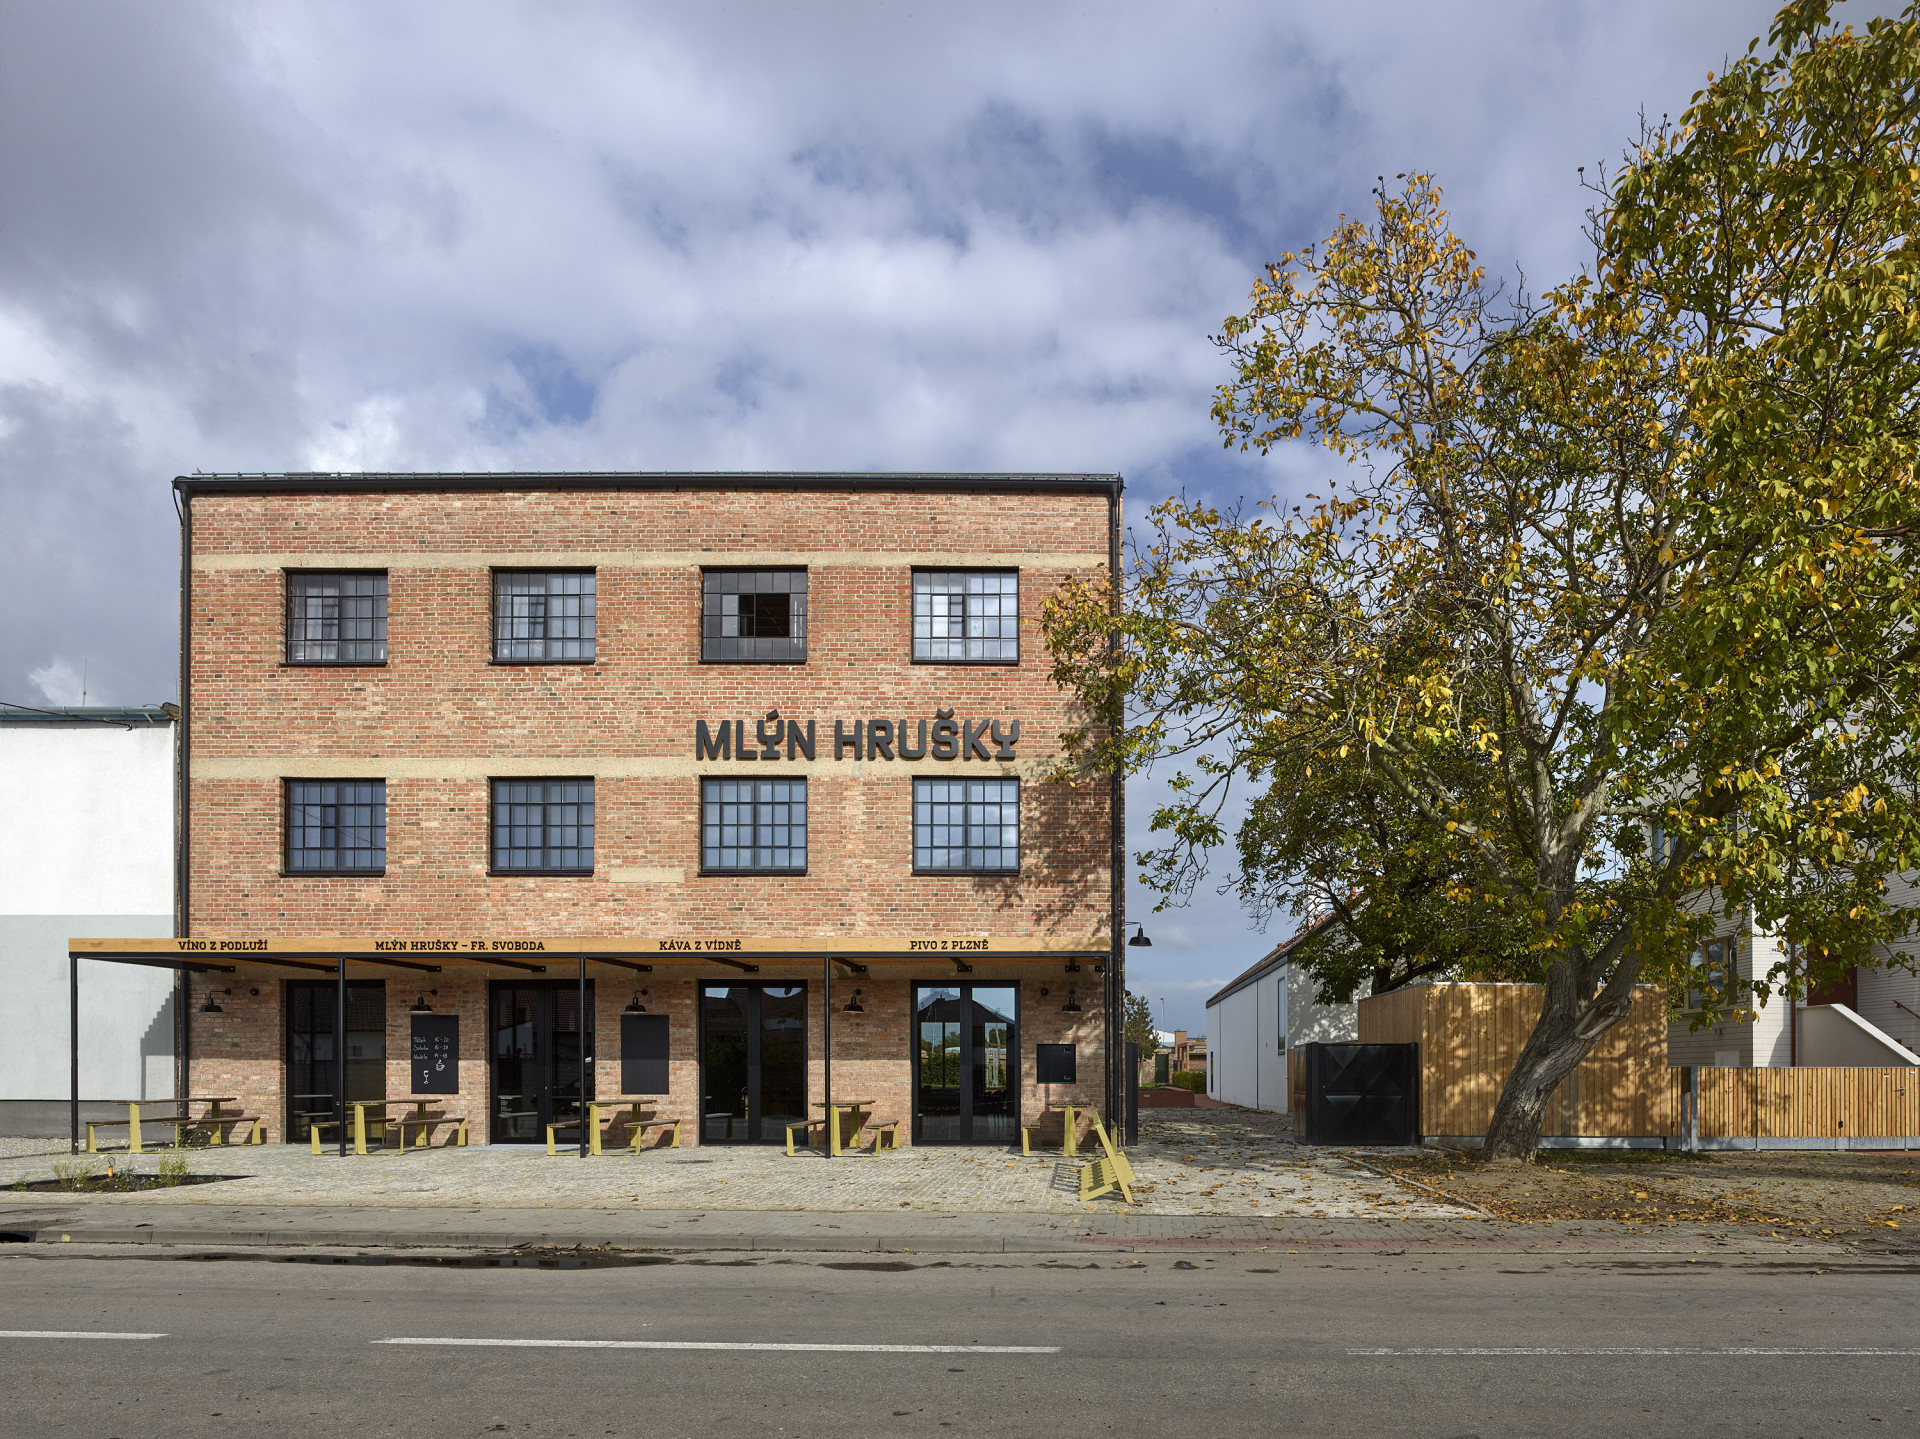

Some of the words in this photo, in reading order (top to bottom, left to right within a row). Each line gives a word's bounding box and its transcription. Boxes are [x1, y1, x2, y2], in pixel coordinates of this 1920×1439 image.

[695, 708, 816, 760] MLÝN
[834, 707, 1020, 760] HRUŠKY
[178, 939, 207, 950] VÍNO
[209, 940, 217, 950] Z
[219, 939, 268, 950] PODLUŽÍ
[375, 939, 407, 950] MLÝN
[410, 939, 459, 950] HRUŠKY
[470, 940, 489, 950] FR.
[492, 940, 545, 950] SVOBODA
[659, 938, 692, 950] KÁVA
[694, 939, 702, 950] Z
[705, 938, 742, 950] VÍDNĚ
[910, 939, 938, 950] PIVO
[941, 939, 949, 950] Z
[951, 938, 989, 950] PLZNĚ
